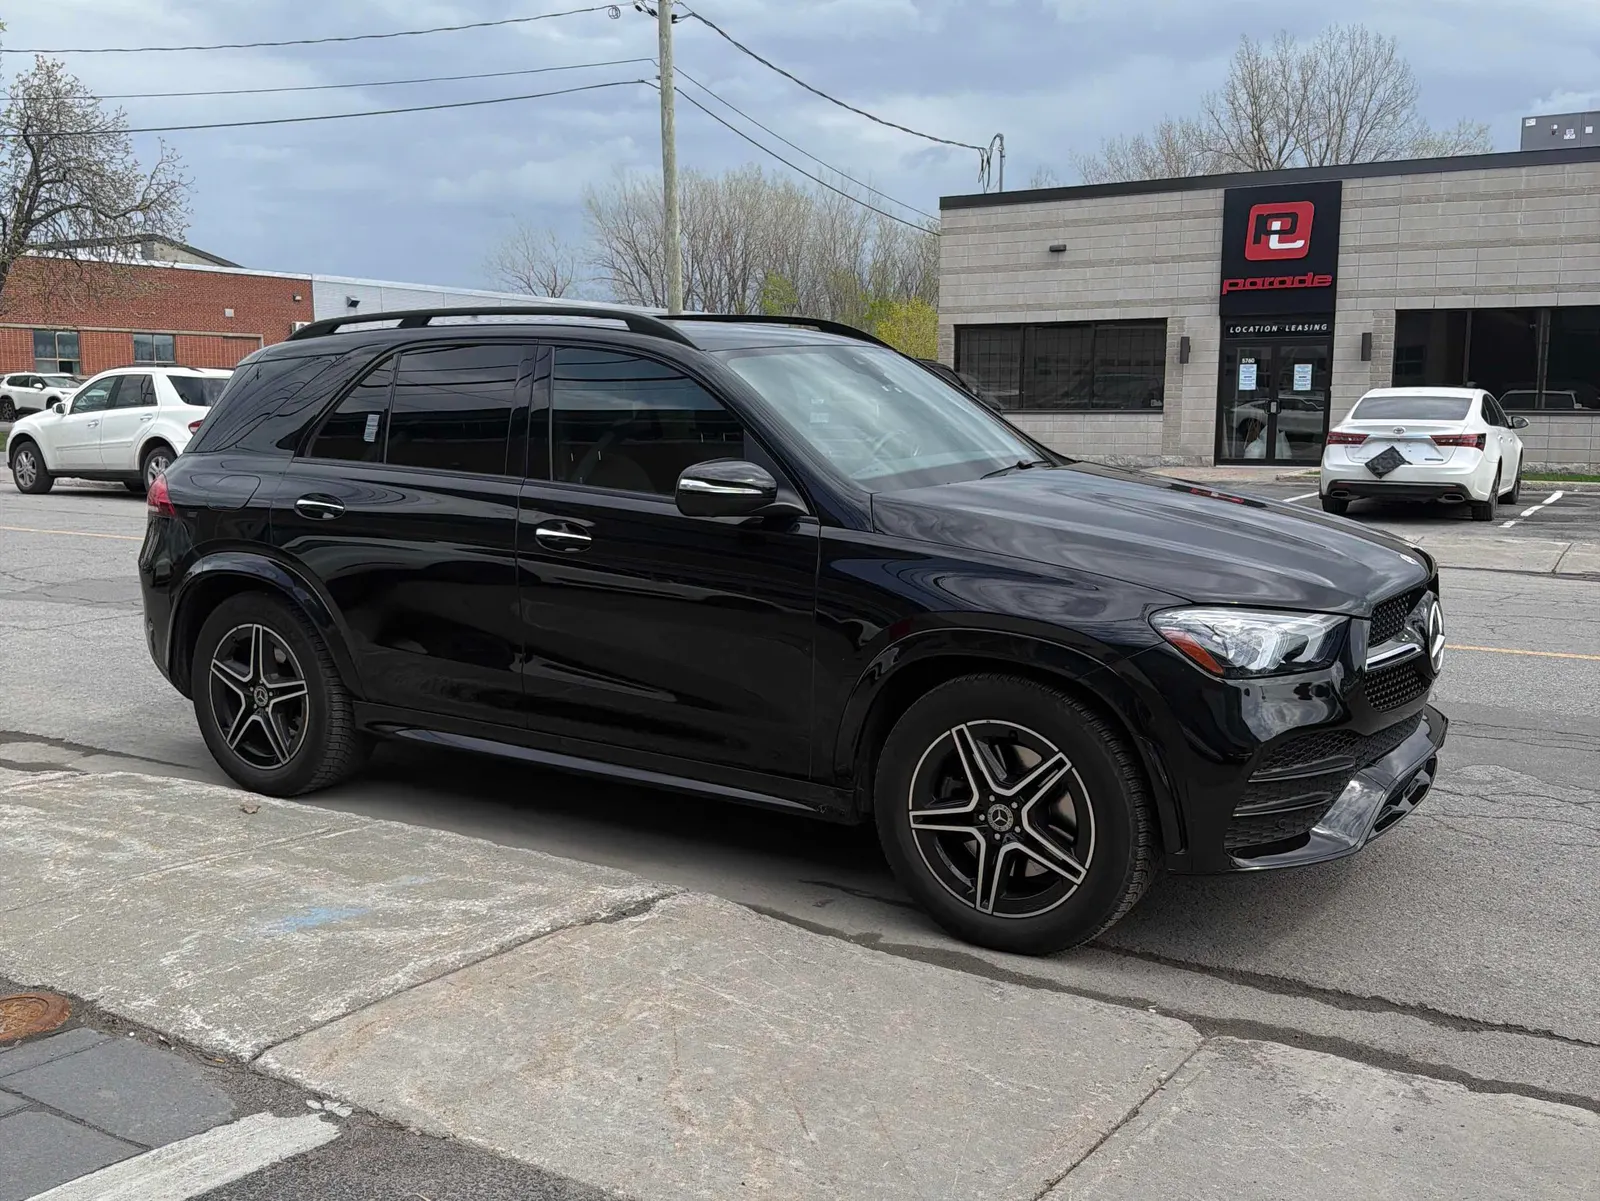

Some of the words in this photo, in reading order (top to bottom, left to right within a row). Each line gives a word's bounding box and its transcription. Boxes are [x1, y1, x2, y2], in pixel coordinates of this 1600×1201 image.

[1221, 272, 1333, 295] parade
[1229, 325, 1278, 333] LOCATION
[1285, 323, 1328, 332] LEASING
